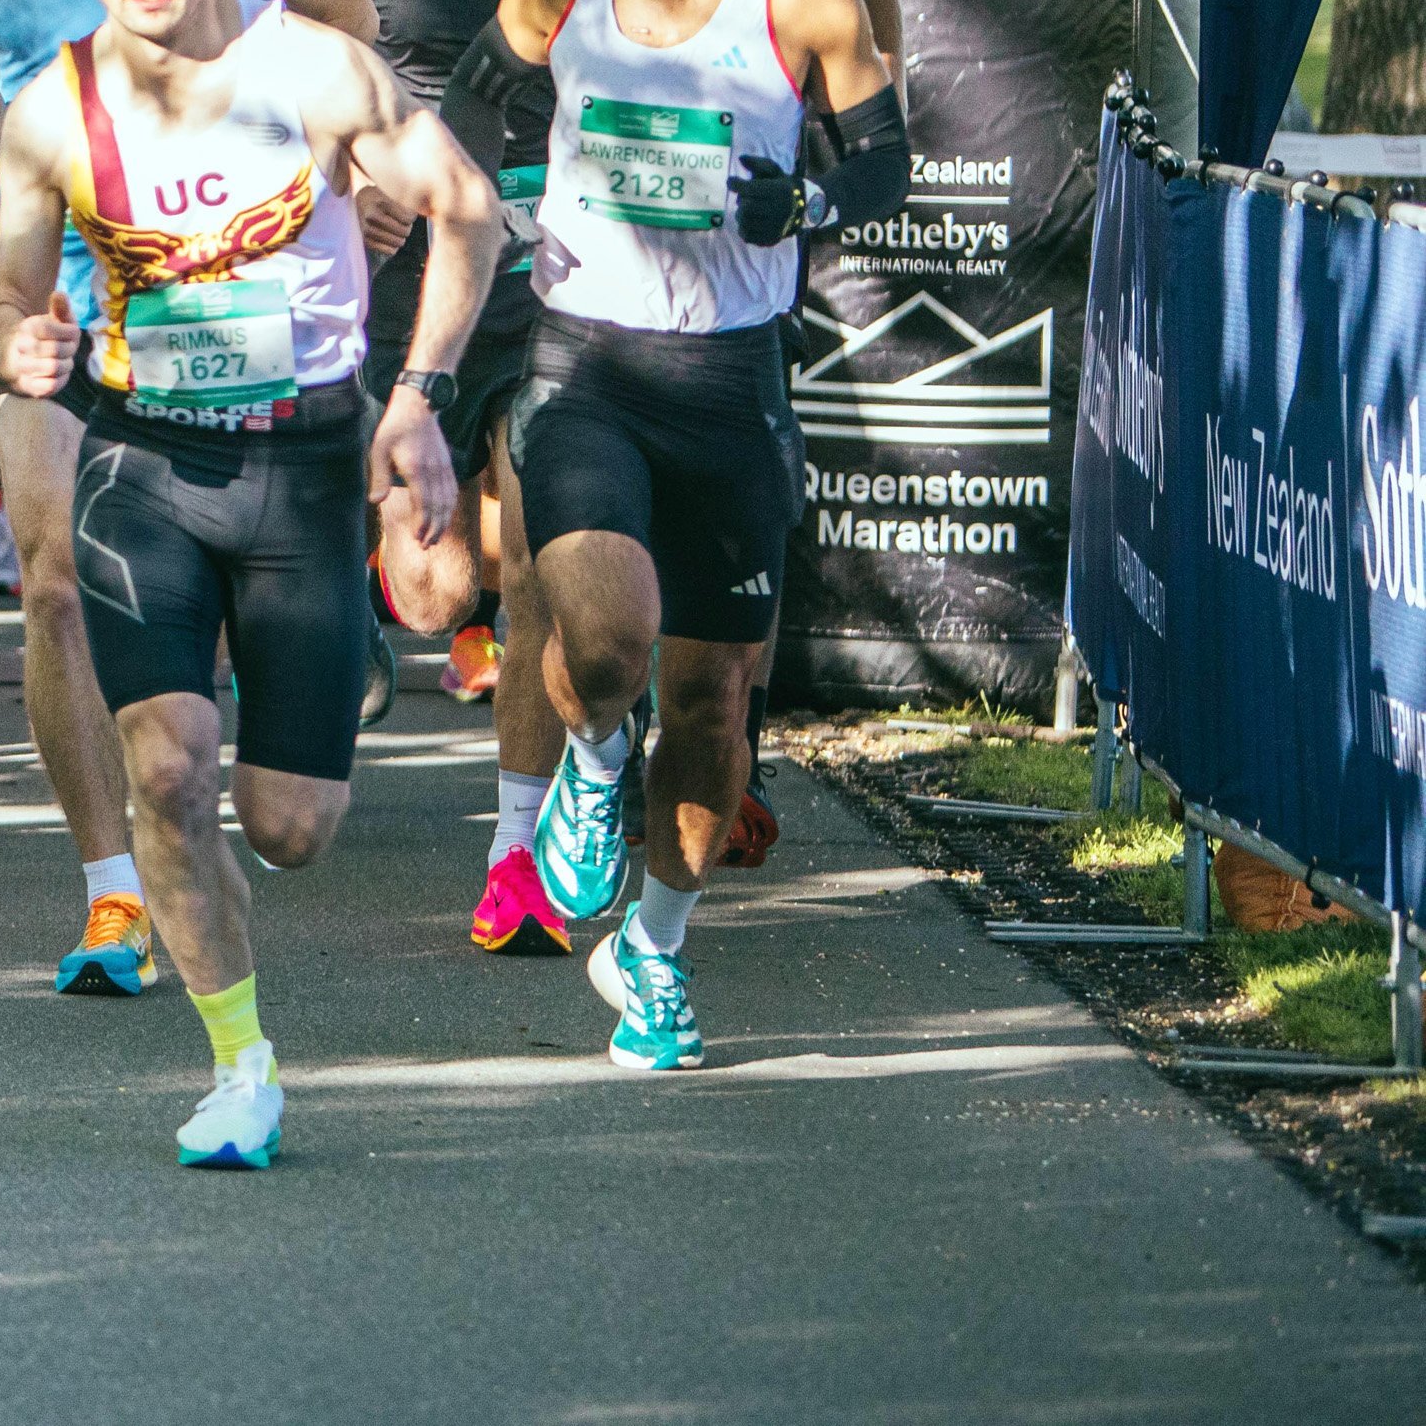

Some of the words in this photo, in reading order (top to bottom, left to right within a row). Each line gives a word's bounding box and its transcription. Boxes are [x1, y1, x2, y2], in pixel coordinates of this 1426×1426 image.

[579, 138, 666, 166] LAWRENCE
[670, 153, 724, 170] WONG
[910, 154, 1013, 185] Zealand
[154, 172, 228, 216] UC
[609, 170, 685, 201] 2128
[839, 255, 953, 275] INTERNATIONAL
[956, 260, 1007, 275] REALTY
[167, 327, 247, 352] RIMKUS
[171, 352, 249, 382] 1627
[805, 461, 1048, 507] Queenstown
[1206, 412, 1247, 559] New
[1252, 428, 1337, 602] Zealand
[818, 509, 1018, 554] Marathon
